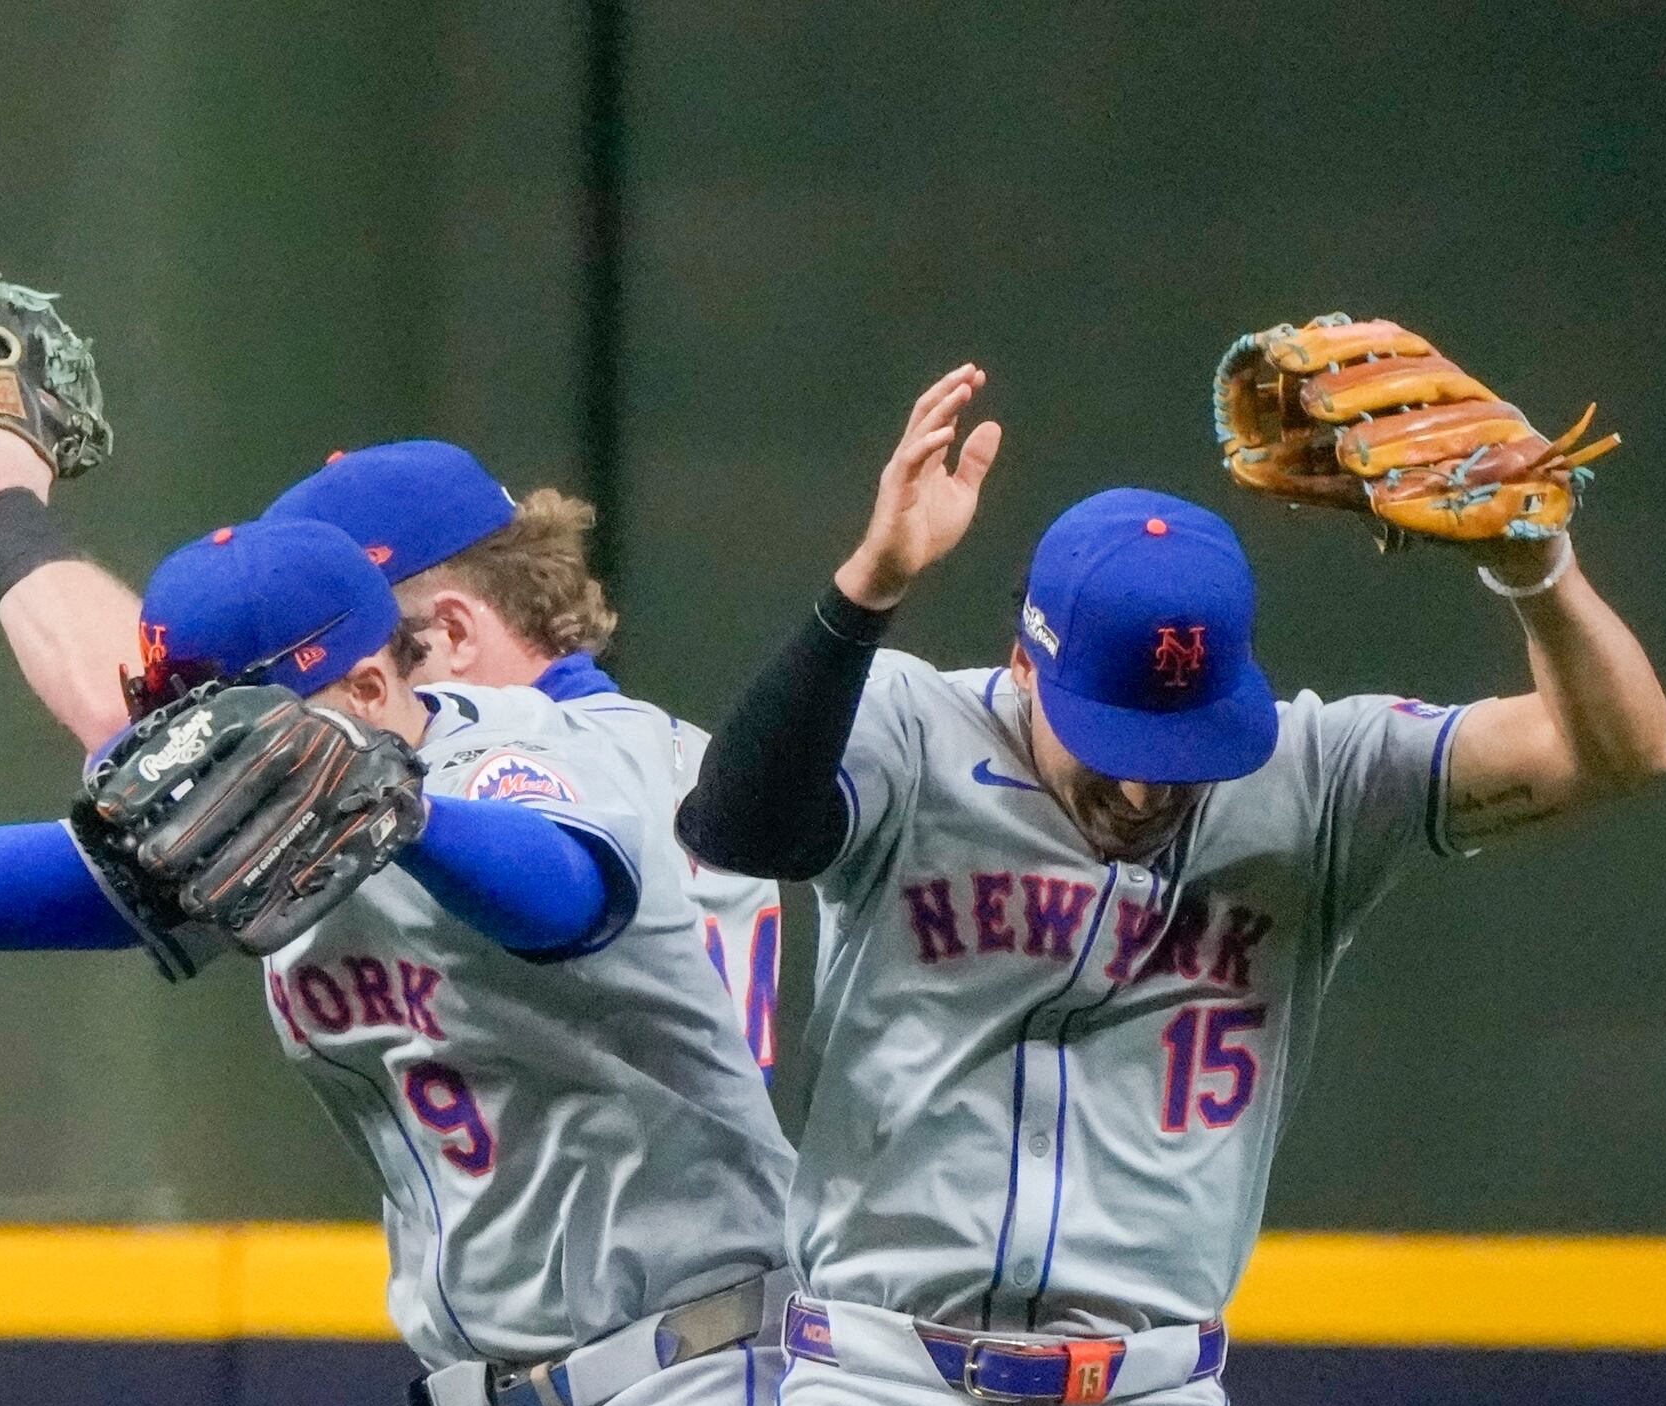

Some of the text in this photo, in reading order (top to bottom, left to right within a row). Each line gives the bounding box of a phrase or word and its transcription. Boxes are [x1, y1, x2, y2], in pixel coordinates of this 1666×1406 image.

[259, 846, 281, 870] GOLD
[279, 821, 305, 849] GLOVE
[903, 871, 1097, 965] NEW
[1160, 1003, 1268, 1134] 15
[404, 1059, 499, 1178] 9
[1077, 1361, 1104, 1400] 15
